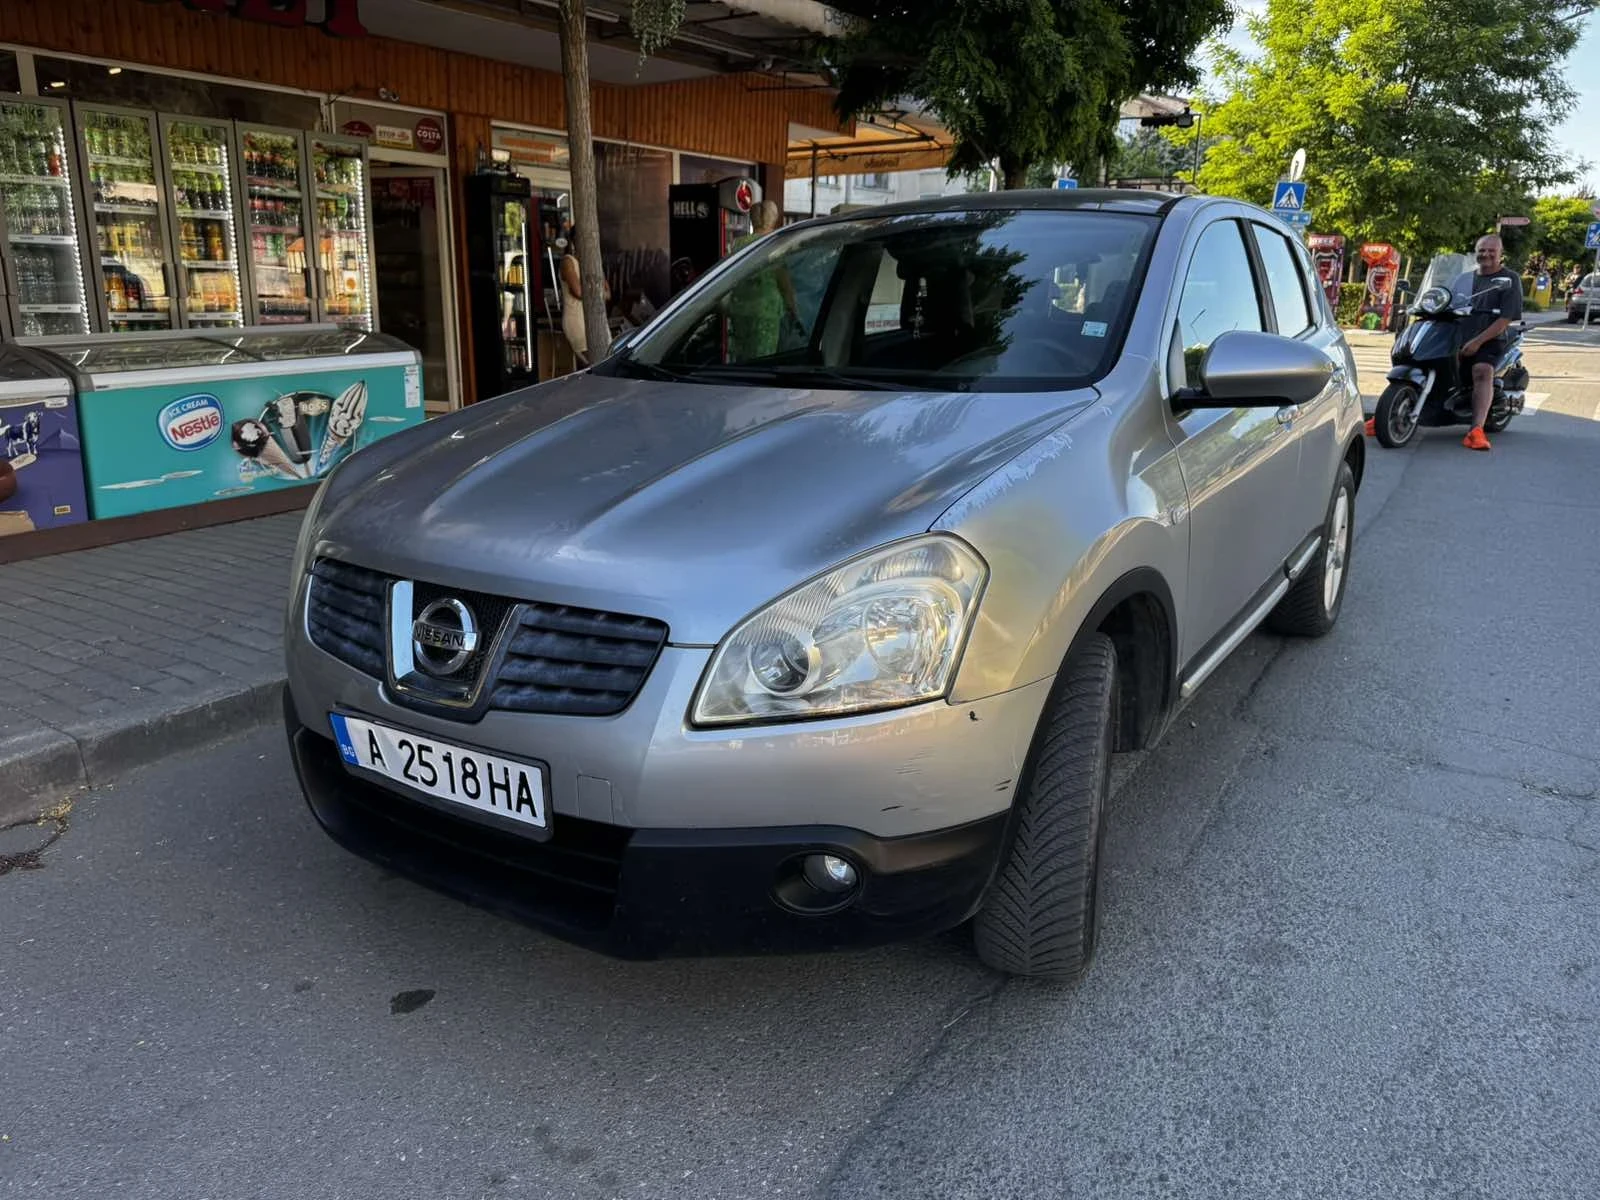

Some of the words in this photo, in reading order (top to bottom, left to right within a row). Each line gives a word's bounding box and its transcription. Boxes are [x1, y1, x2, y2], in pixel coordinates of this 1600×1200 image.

[416, 129, 442, 140] COSTA
[673, 200, 696, 216] HELL
[169, 405, 182, 418] ICE
[181, 399, 209, 411] CREAM
[414, 623, 465, 648] NISSAN
[341, 743, 356, 758] BG
[368, 728, 390, 771] A
